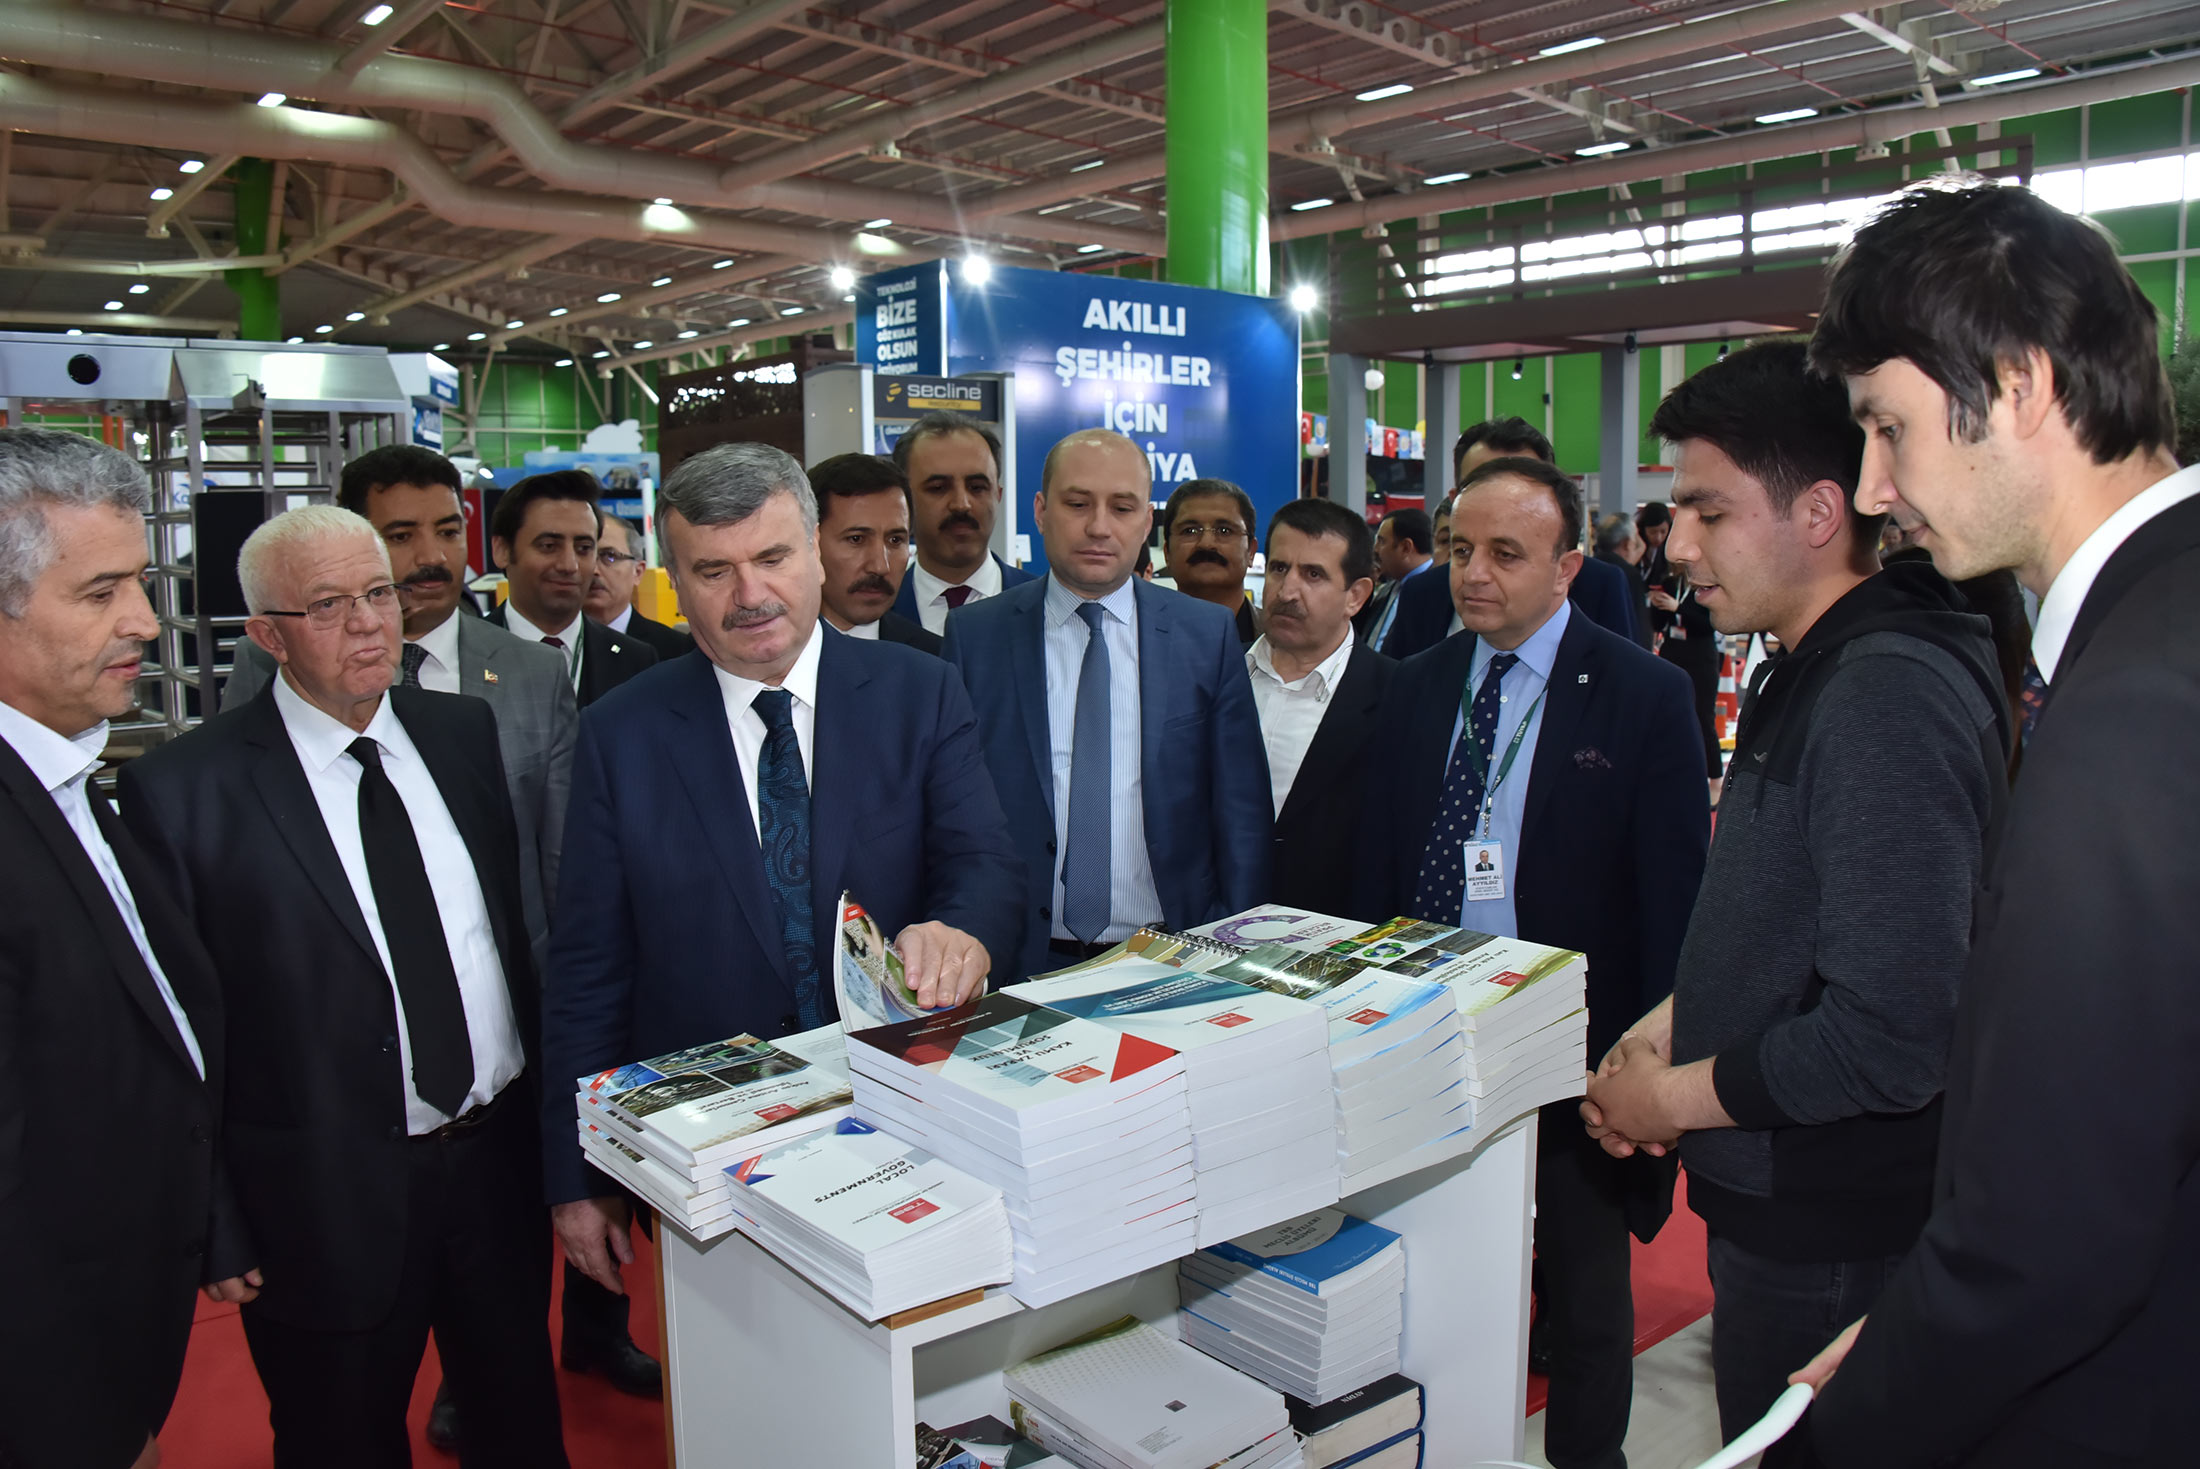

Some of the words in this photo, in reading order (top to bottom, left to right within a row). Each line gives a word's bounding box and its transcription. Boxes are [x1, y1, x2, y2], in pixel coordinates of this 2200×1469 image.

[876, 296, 917, 329] BİZE
[1082, 298, 1186, 337] AKILLI
[876, 328, 892, 343] GÖZ
[893, 326, 917, 339] KULAK
[876, 340, 918, 361] OLSUN
[1055, 341, 1211, 388] ŞEHİRLER
[907, 382, 982, 399] secline
[1104, 390, 1168, 438] İÇİN
[969, 1034, 1052, 1061] SORUMLULUK
[1016, 1049, 1033, 1057] VE
[1035, 1041, 1072, 1056] KAMU
[986, 1055, 1033, 1070] ZARARI
[814, 1160, 906, 1204] GOVERNMENTS
[875, 1164, 914, 1185] LOCAL
